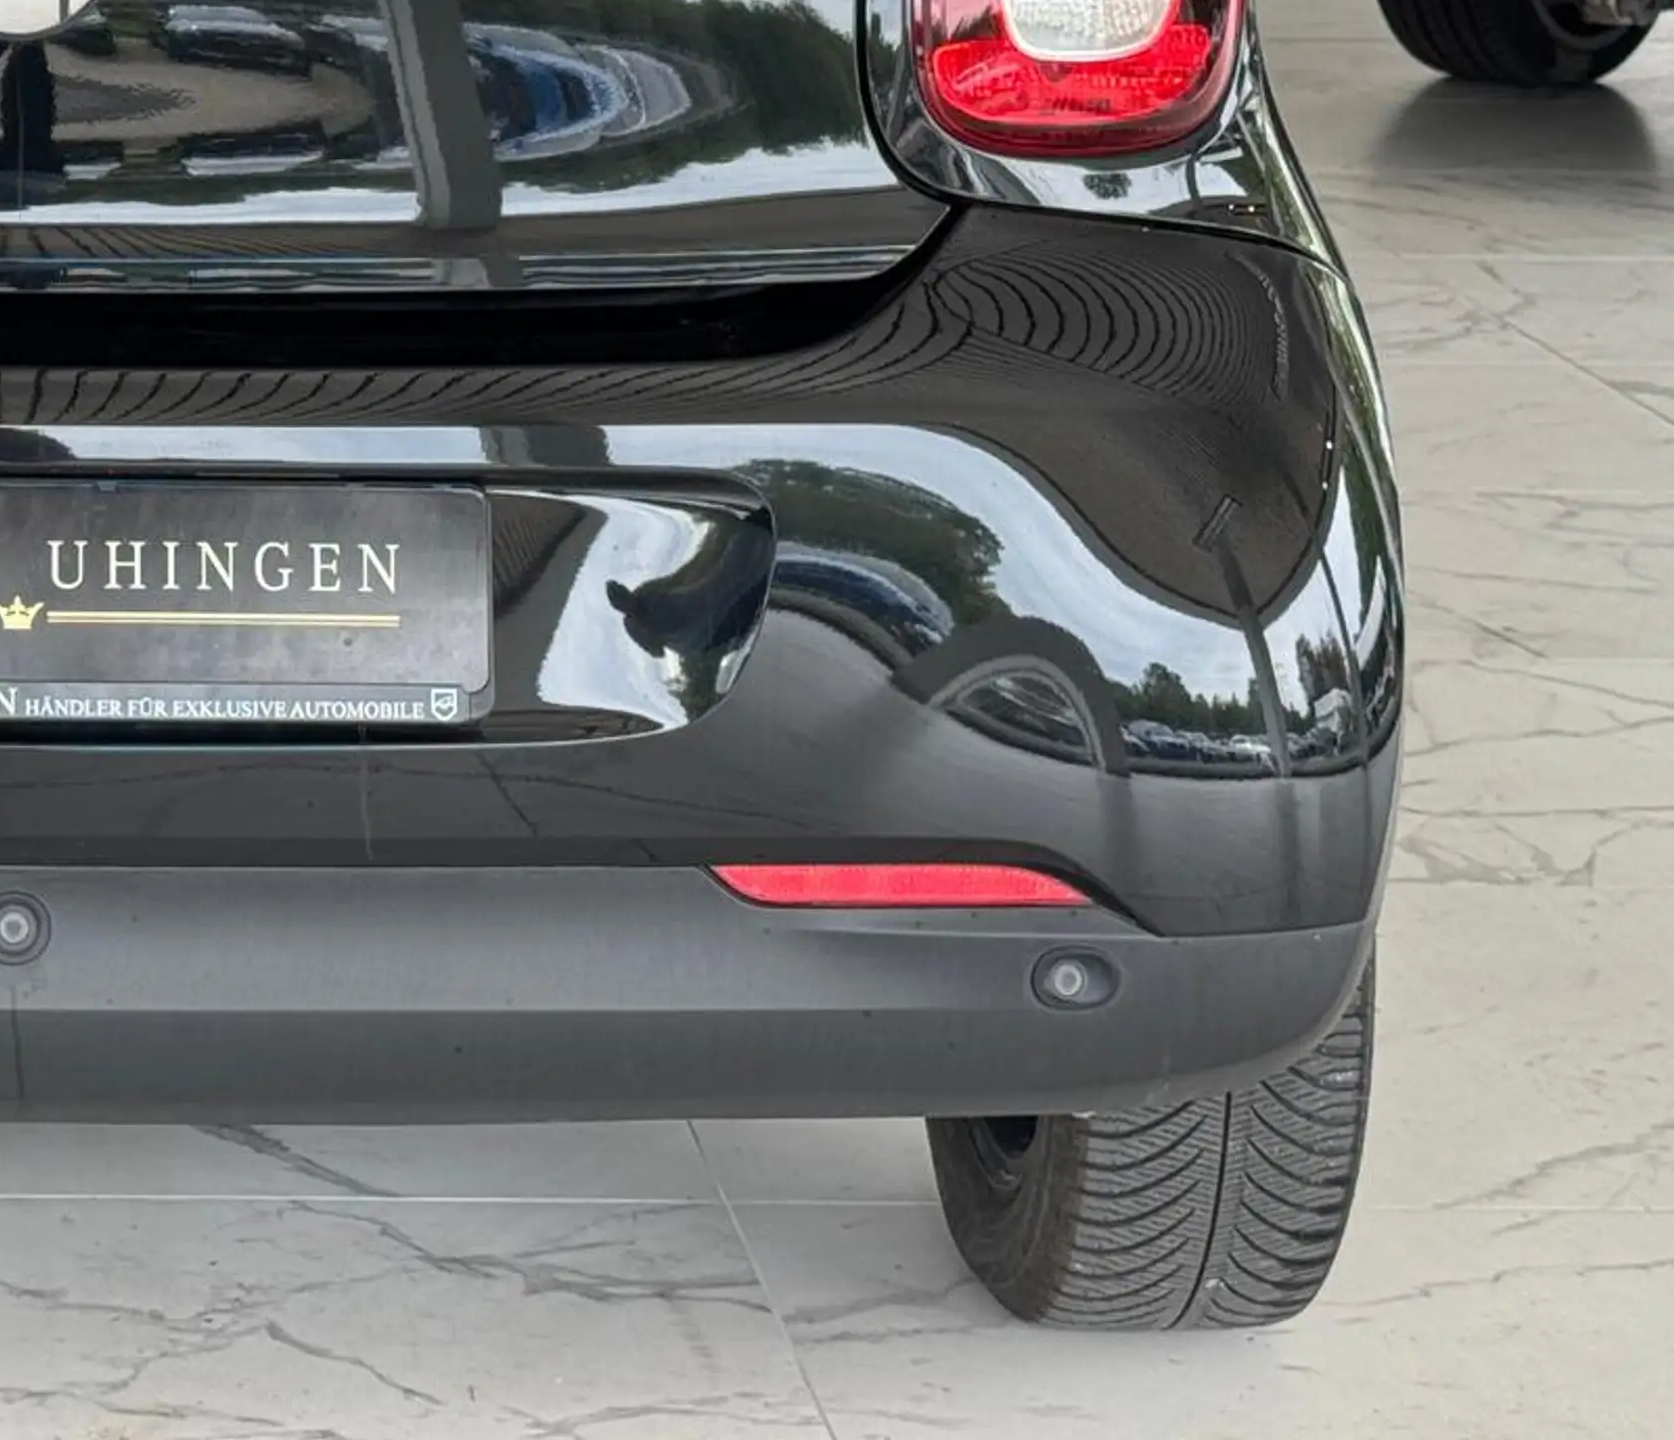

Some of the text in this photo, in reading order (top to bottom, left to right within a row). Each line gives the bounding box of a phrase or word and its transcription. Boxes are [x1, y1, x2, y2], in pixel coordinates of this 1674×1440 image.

[46, 539, 401, 594] UHINGEN
[25, 695, 123, 718] HÄNDLER
[128, 696, 166, 718] FÜR
[172, 699, 287, 720] EXKLUSIVE
[290, 700, 425, 721] AUTOMOBILE
